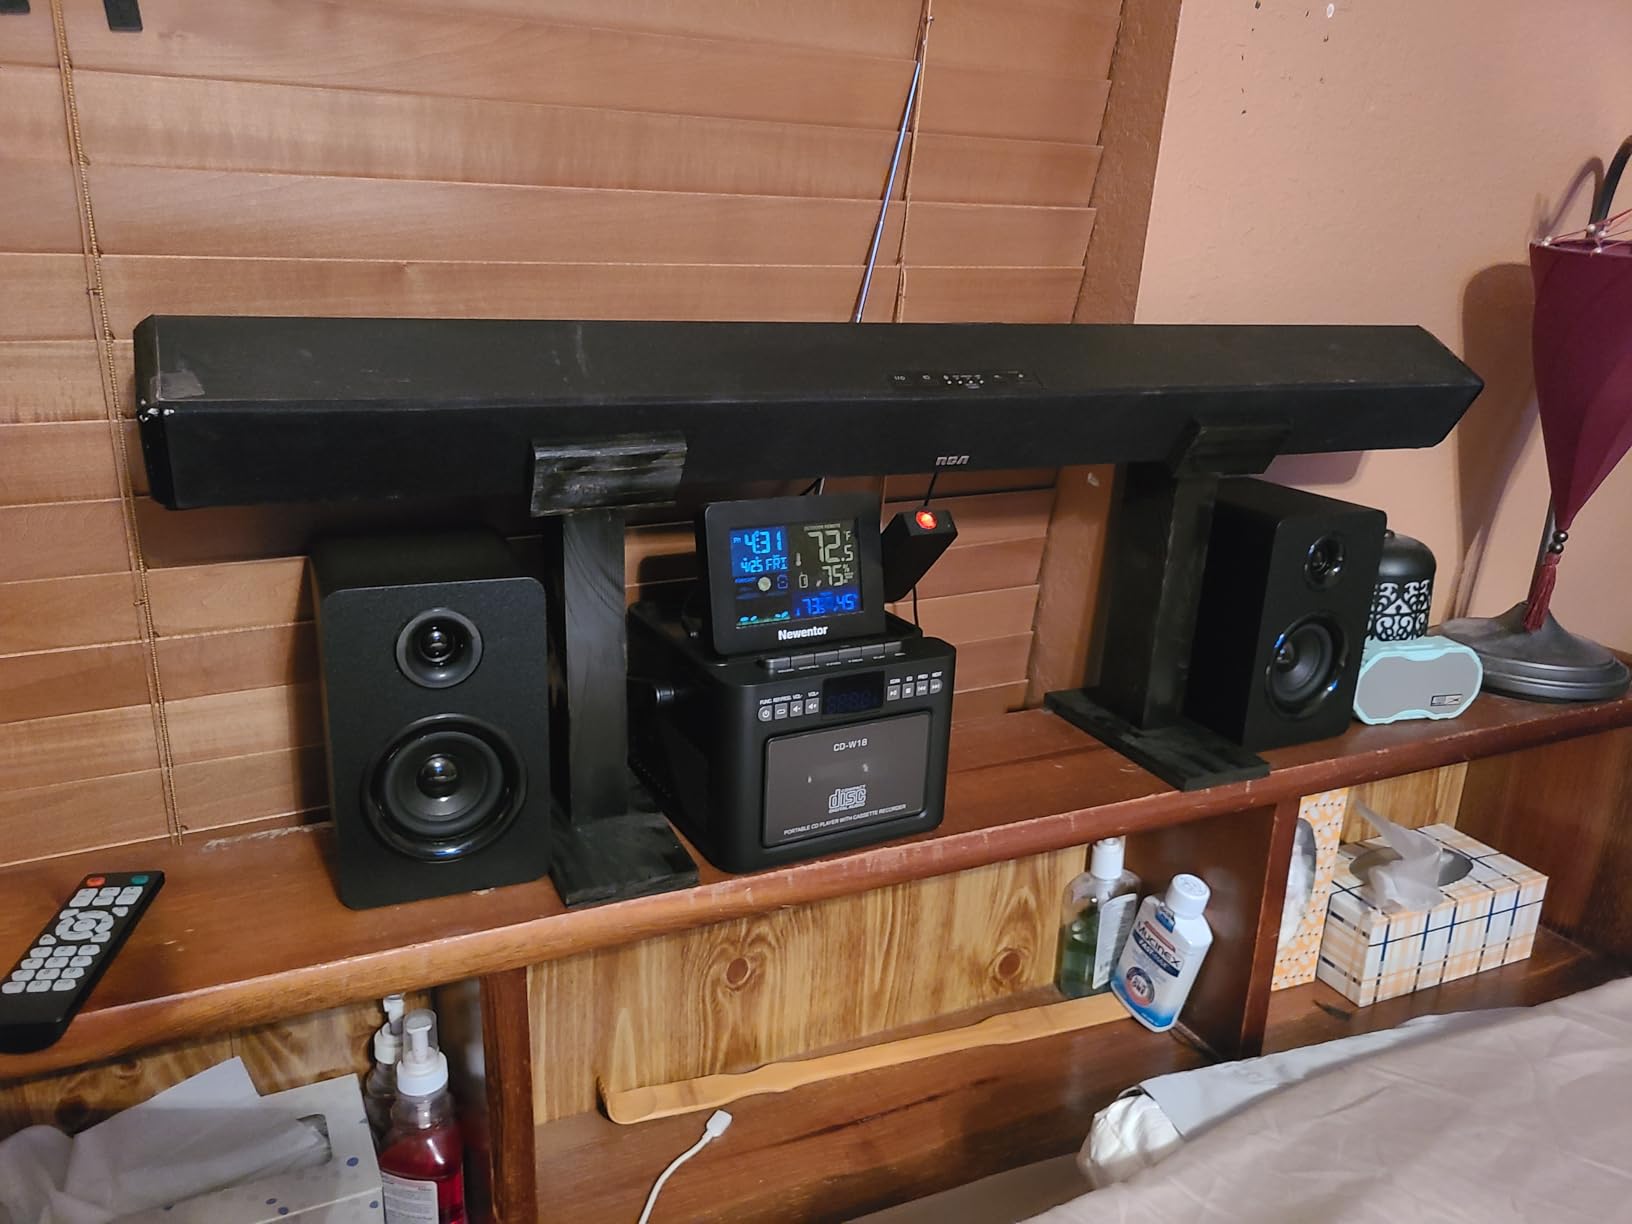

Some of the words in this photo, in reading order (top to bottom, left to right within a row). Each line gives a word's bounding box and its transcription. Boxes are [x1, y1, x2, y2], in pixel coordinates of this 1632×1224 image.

[935, 455, 970, 466] RCA
[778, 626, 828, 640] Newentor
[783, 824, 810, 835] PORTABLE
[820, 818, 839, 827] PLAYER
[852, 809, 878, 820] CASSETTE
